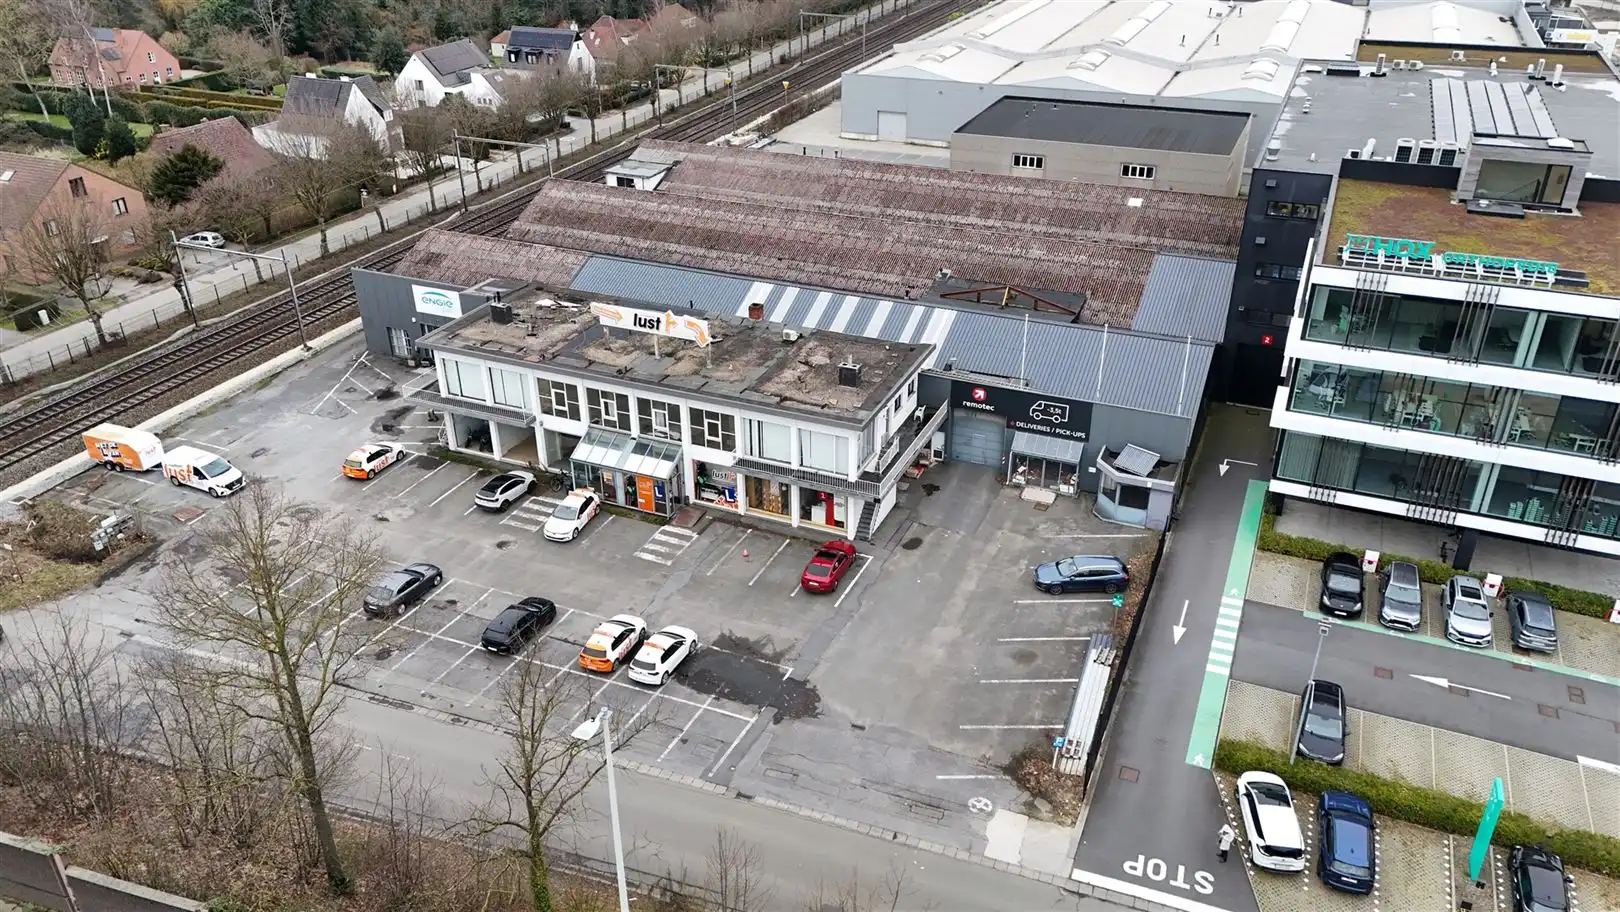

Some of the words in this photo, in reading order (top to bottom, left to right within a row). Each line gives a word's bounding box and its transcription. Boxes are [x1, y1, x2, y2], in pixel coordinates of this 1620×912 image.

[1374, 237, 1436, 260] HOX
[633, 313, 661, 330] lust
[962, 400, 995, 412] remotec
[1016, 421, 1051, 433] DELIVERIES
[1055, 428, 1086, 439] PICK-UPS
[164, 463, 192, 482] lust
[725, 489, 734, 502] L
[1122, 854, 1215, 895] STOP
